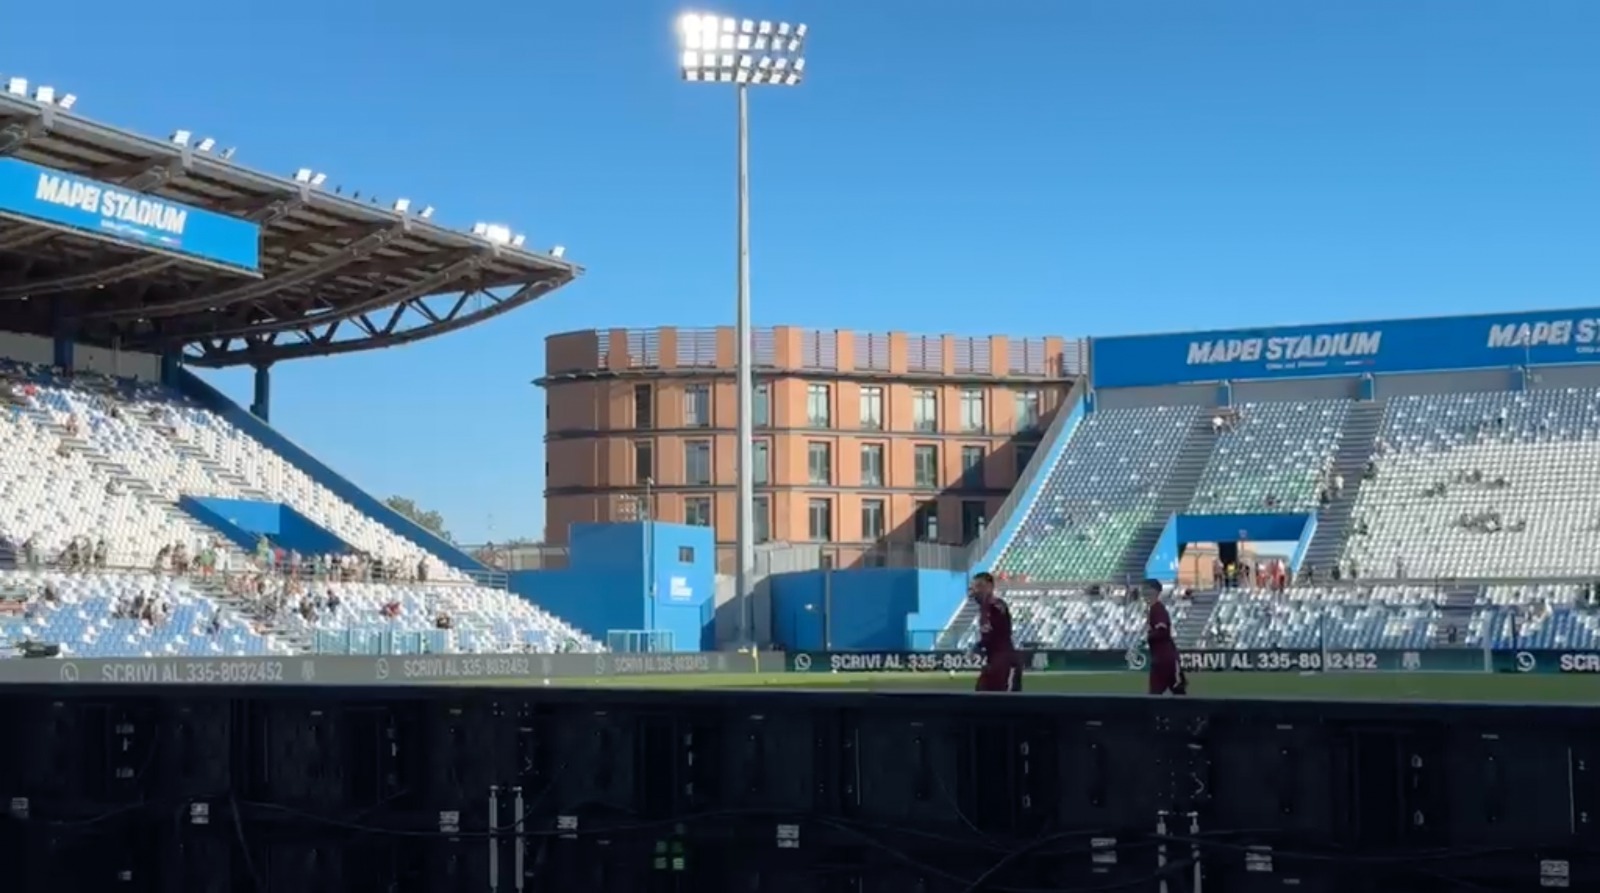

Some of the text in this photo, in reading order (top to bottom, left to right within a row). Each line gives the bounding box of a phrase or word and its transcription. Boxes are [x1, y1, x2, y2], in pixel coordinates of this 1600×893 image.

[36, 173, 101, 213] MAPEI
[101, 190, 188, 235] STADIUM
[1486, 320, 1573, 348] MAPEI
[1186, 331, 1382, 365] MAPEI STADIUM
[102, 662, 283, 682] SCRIVI AL 335-8032452
[831, 654, 881, 670] SCRIVI
[884, 654, 904, 669] AL
[1179, 652, 1226, 669] CRIVI
[1231, 653, 1253, 669] AL
